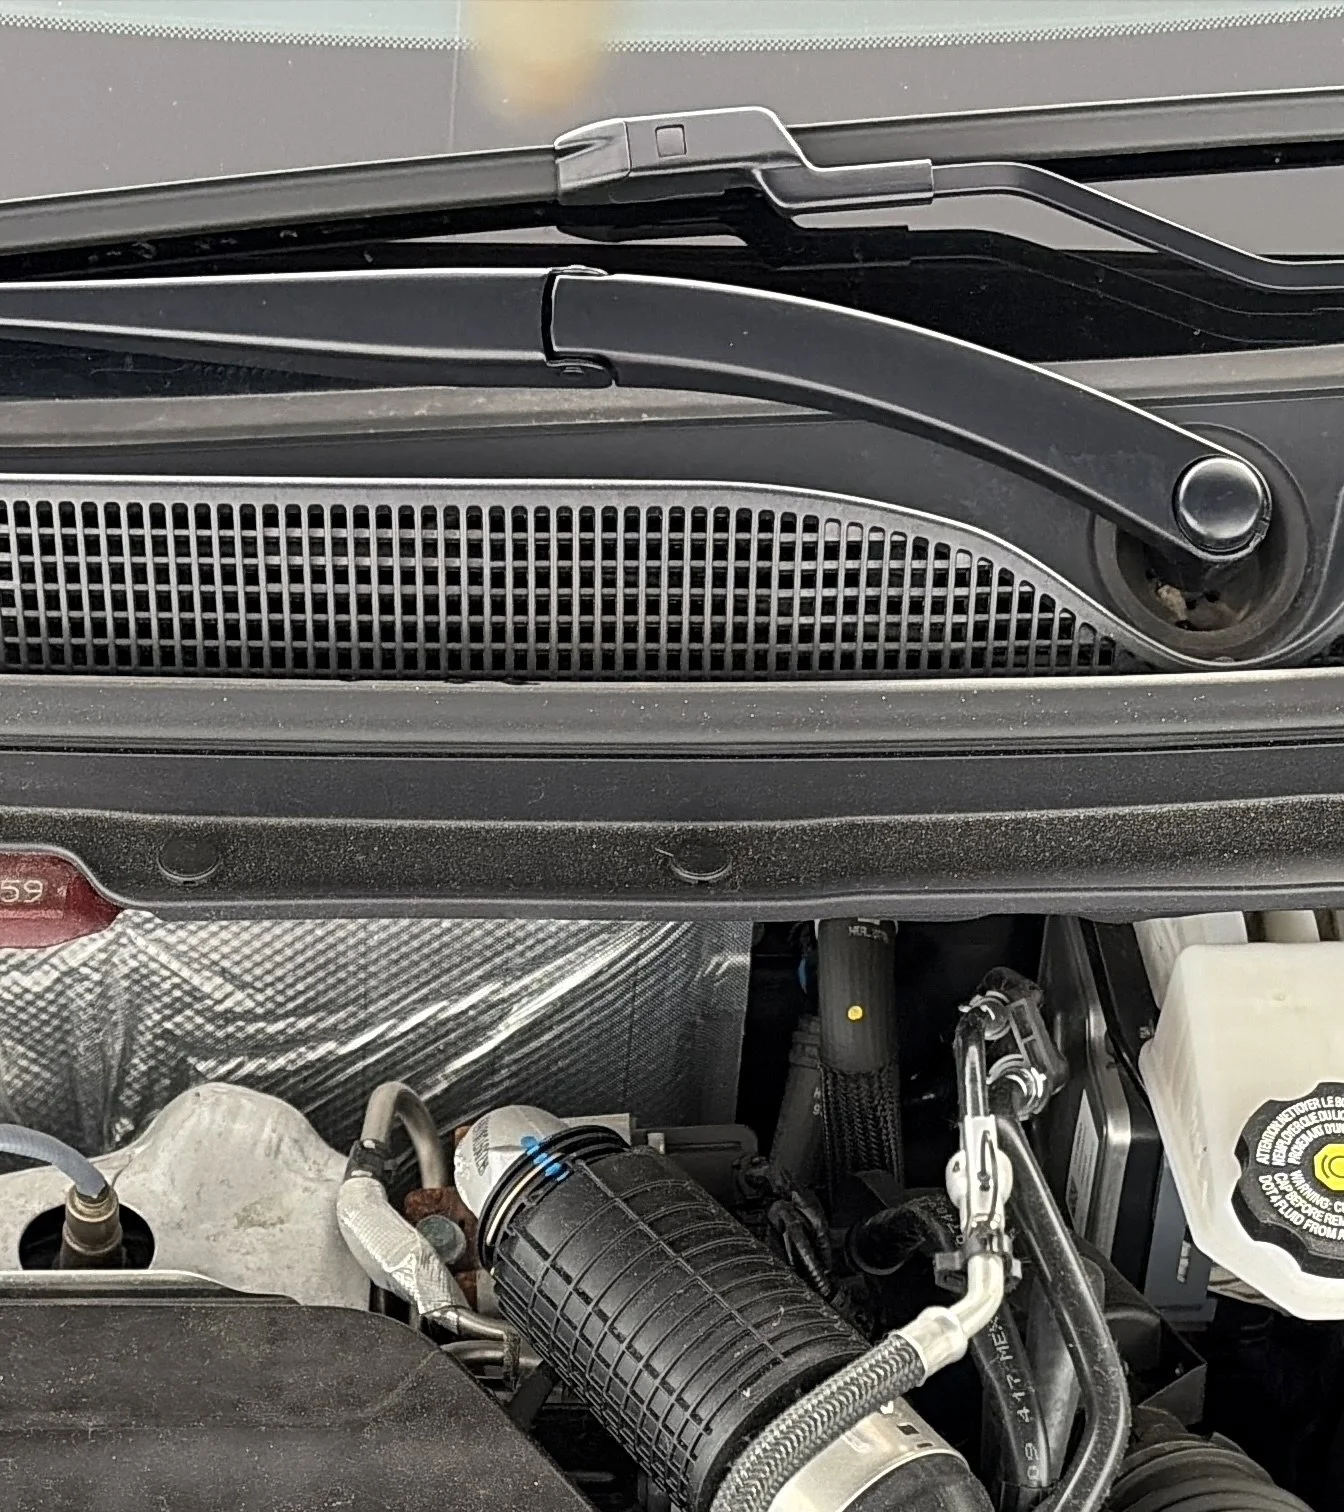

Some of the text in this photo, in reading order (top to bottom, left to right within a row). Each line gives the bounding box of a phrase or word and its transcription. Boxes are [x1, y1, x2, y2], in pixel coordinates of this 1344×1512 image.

[1321, 1096, 1334, 1108] LE
[1273, 1173, 1293, 1196] CAP
[1288, 1191, 1325, 1221] BEFORE
[1274, 1199, 1305, 1225] FLUID
[1303, 1219, 1337, 1239] FROM
